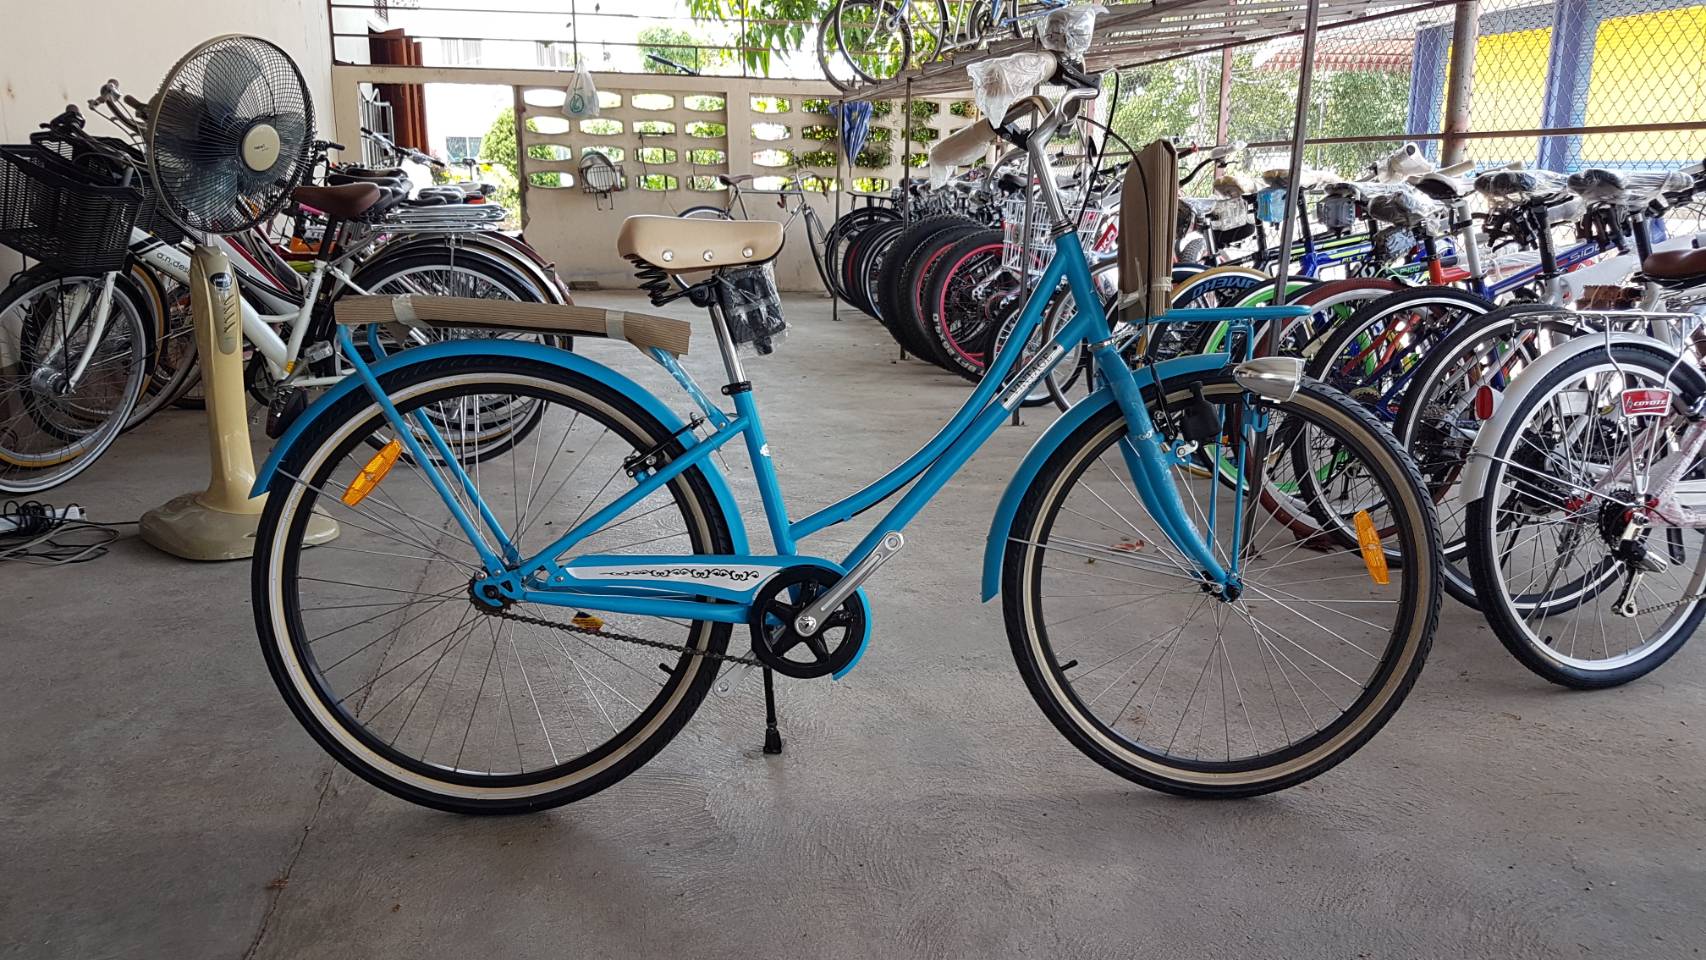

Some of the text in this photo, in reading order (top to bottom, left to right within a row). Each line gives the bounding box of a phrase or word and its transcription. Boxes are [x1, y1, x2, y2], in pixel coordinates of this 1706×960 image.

[156, 253, 189, 273] a.n.des
[1010, 352, 1052, 396] VINTAGE
[1633, 399, 1667, 407] COYOTE
